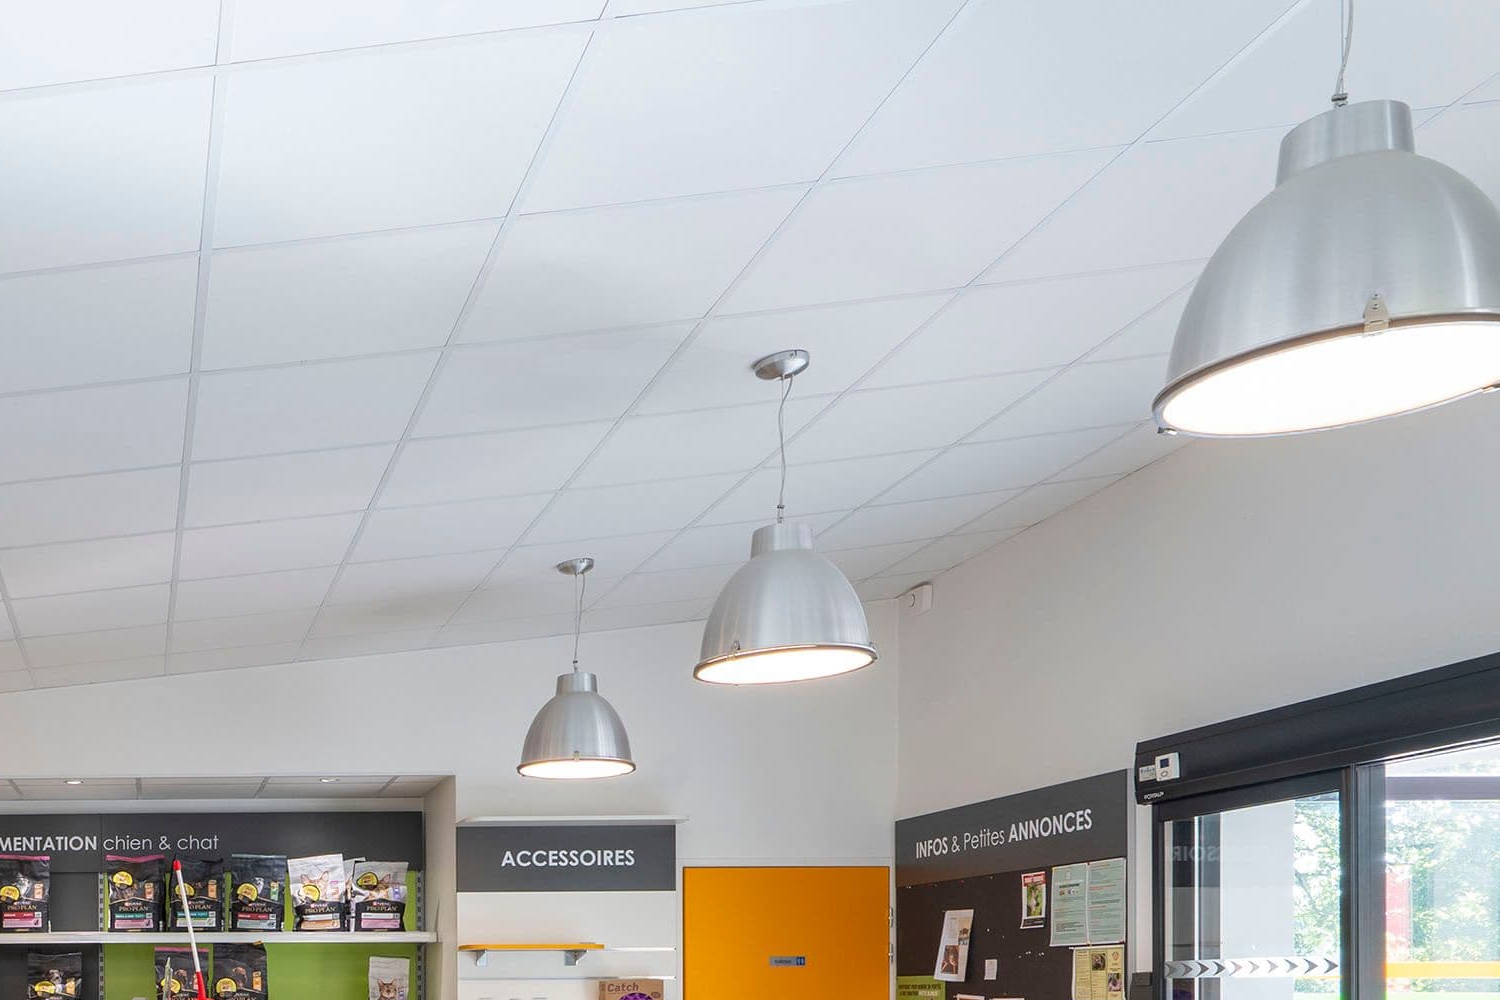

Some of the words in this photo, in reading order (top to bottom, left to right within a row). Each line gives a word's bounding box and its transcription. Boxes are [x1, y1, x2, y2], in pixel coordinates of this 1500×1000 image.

[102, 834, 153, 851] chien
[158, 836, 172, 851] &
[176, 834, 220, 851] chat
[915, 836, 949, 859] INFOS
[951, 834, 961, 853] &
[963, 828, 1005, 851] Petites
[1008, 808, 1093, 843] ANNONCES
[500, 849, 636, 868] ACCESSOIRES
[607, 982, 639, 993] Catch
